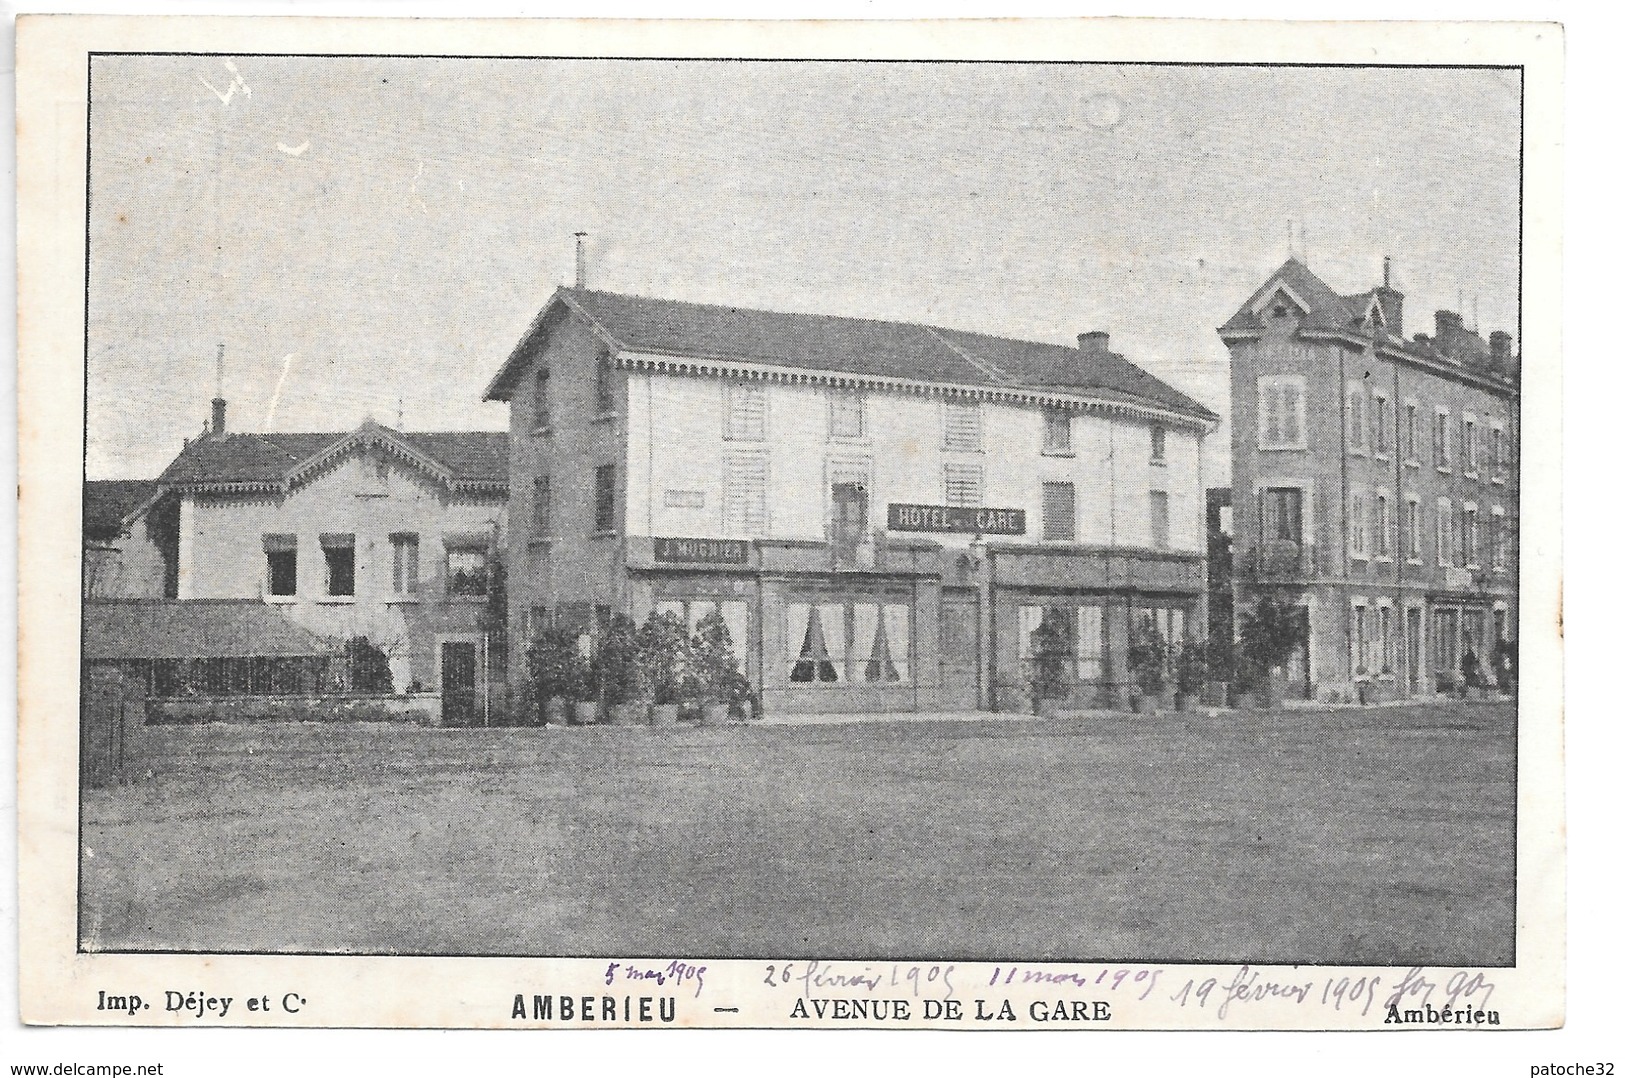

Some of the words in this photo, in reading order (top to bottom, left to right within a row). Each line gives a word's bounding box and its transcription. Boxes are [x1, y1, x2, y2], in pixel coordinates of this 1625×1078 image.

[898, 507, 951, 528] HOTEL
[604, 962, 621, 986] 5
[763, 964, 794, 988] 26
[891, 965, 955, 1003] 1905
[989, 967, 1018, 986] 11
[96, 990, 150, 1016] Imp.
[165, 991, 233, 1018] Déjey
[246, 995, 270, 1012] et
[511, 993, 676, 1022] AMBERIEU
[789, 997, 912, 1021] AVENUE
[922, 1000, 964, 1021] DE
[974, 999, 1017, 1022] LA
[1029, 1000, 1112, 1022] GARE
[1169, 979, 1218, 1008] 19
[1322, 975, 1382, 1017] 1905
[1384, 1003, 1501, 1025] Ambérieu
